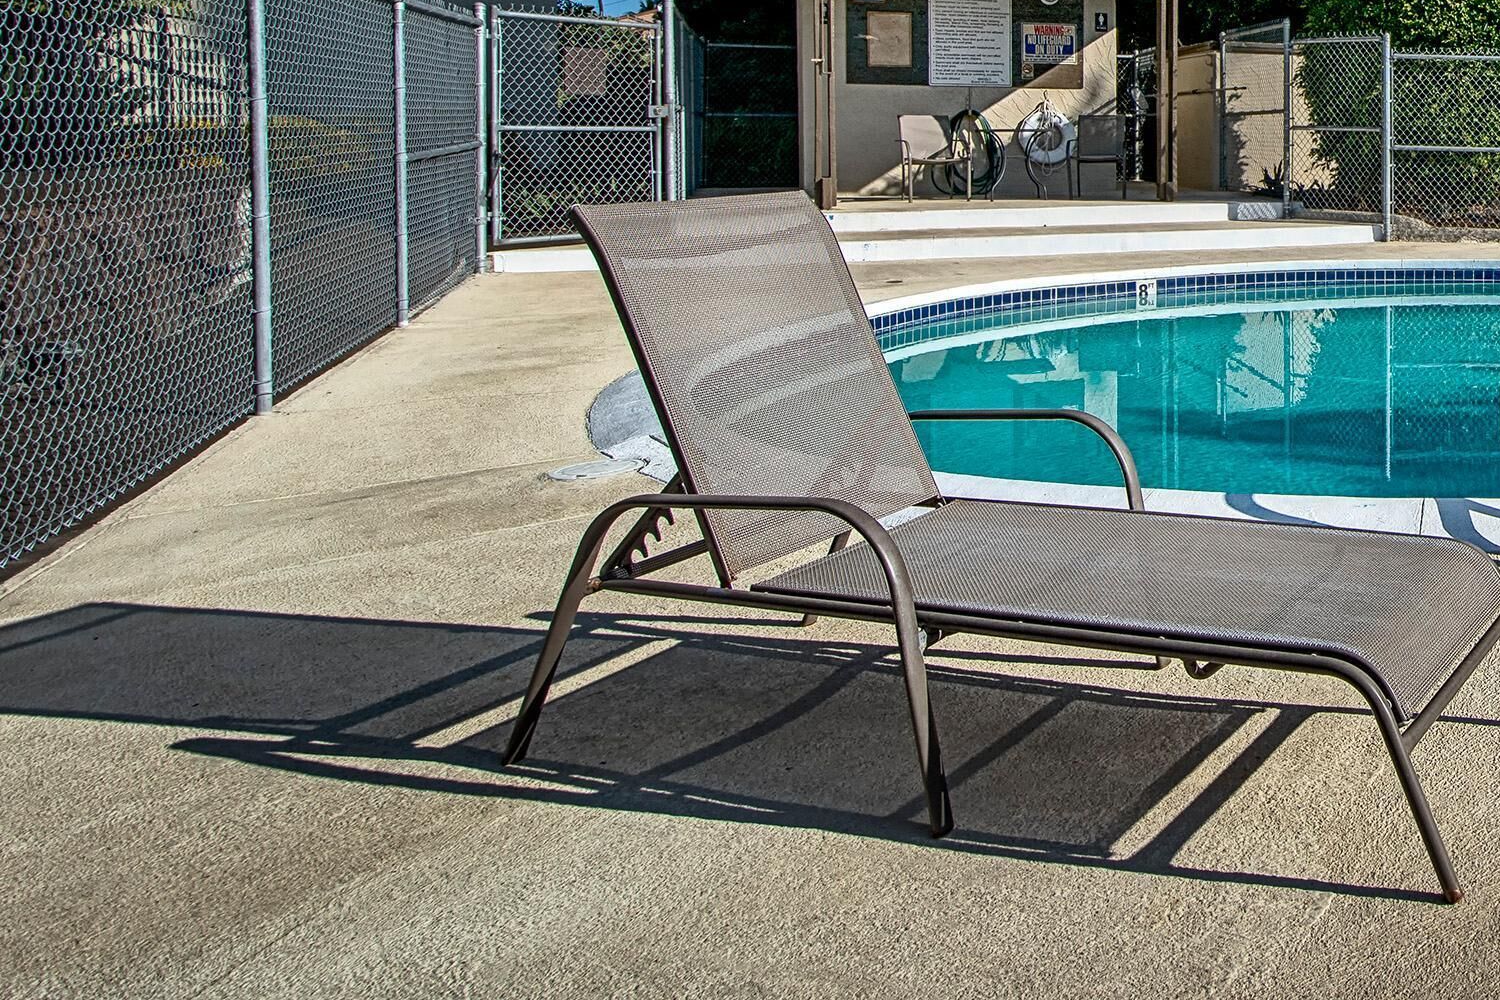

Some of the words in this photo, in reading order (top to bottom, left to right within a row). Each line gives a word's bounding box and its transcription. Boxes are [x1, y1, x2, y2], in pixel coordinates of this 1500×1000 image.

[1034, 24, 1064, 35] WARNING
[1027, 35, 1037, 45] NO
[1037, 35, 1071, 45] LIFEGUARD
[1035, 45, 1044, 55] ON
[1046, 45, 1064, 55] DUTY
